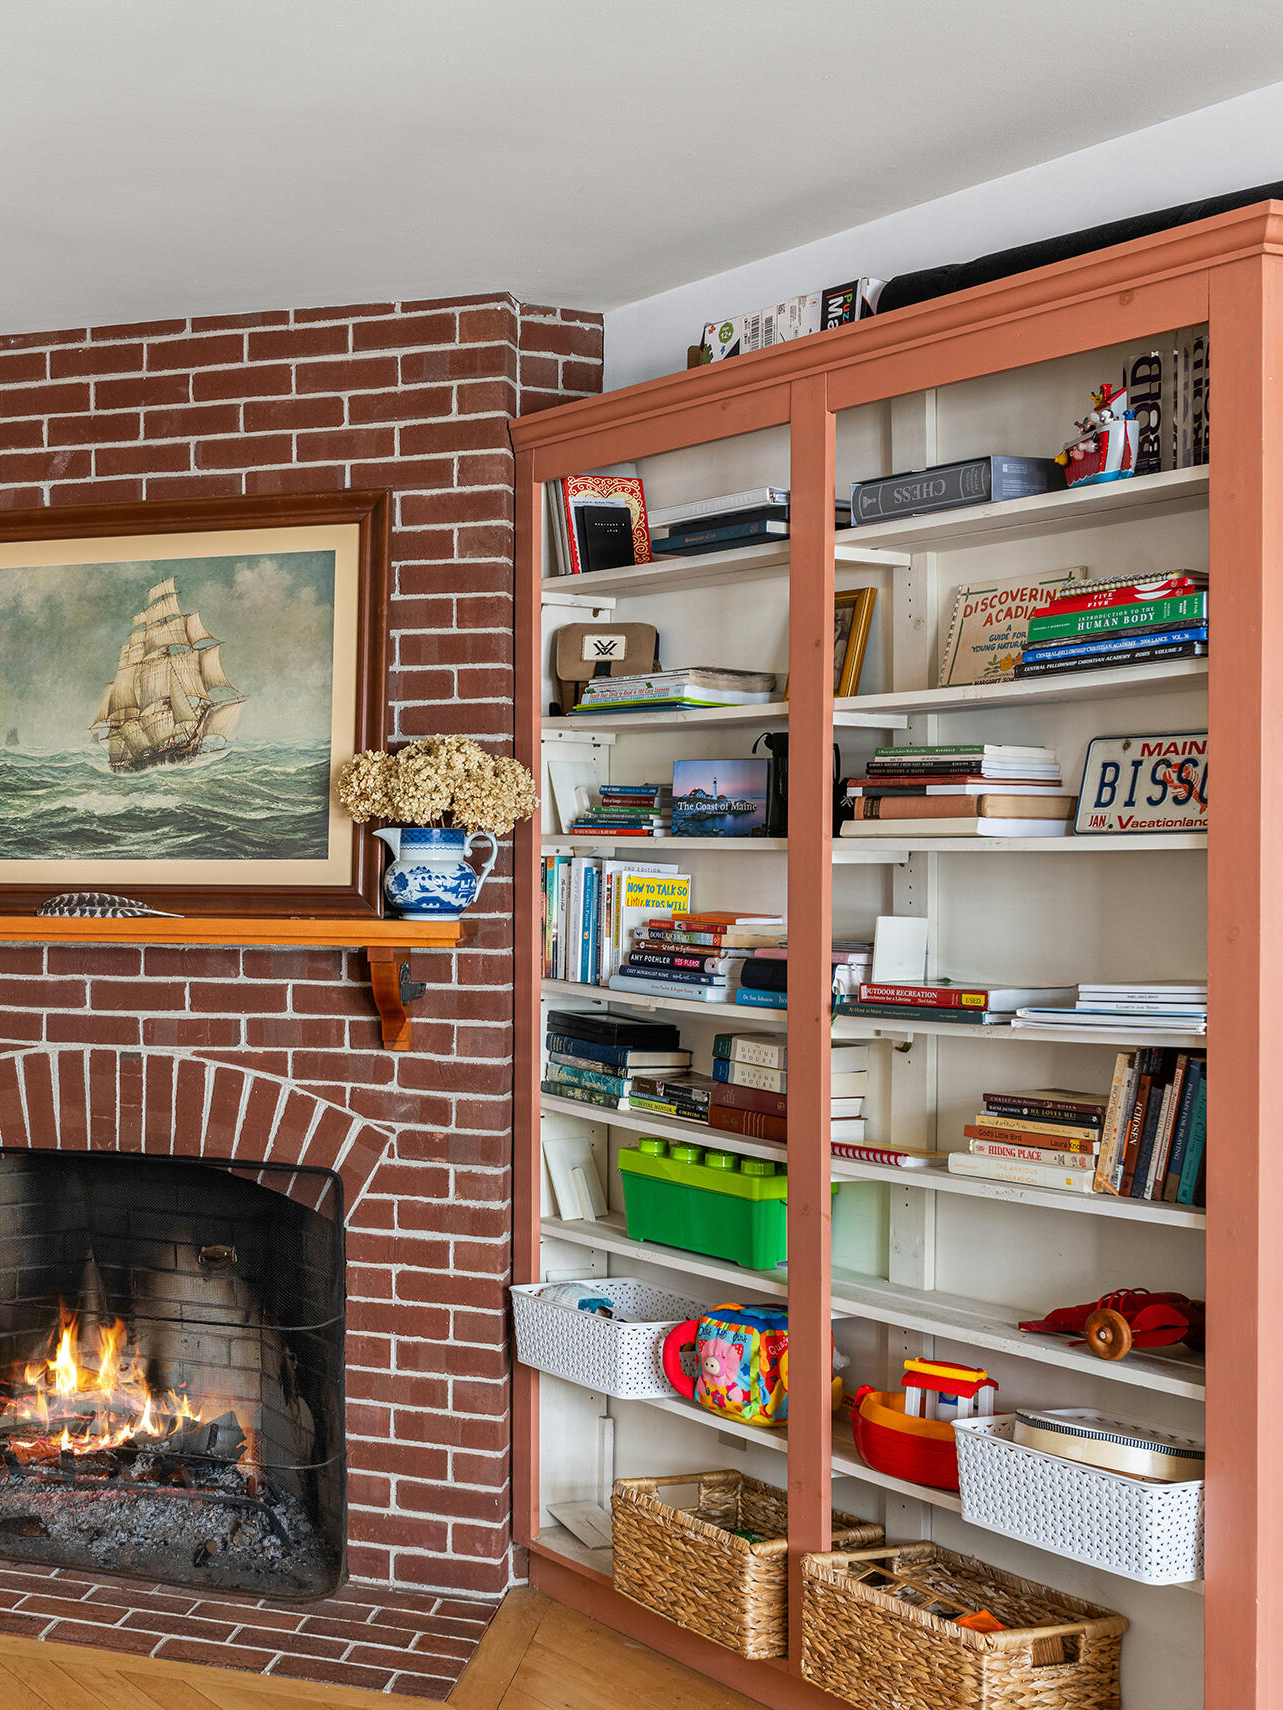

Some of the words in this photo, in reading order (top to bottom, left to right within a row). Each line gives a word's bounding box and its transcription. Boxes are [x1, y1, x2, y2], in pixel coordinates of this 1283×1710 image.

[893, 478, 947, 505] CHESS
[1093, 592, 1113, 600] FIVE
[962, 587, 1058, 619] DISCOVERIN
[1087, 600, 1109, 608] FIVE
[982, 605, 1038, 628] ACADIA
[1077, 618, 1119, 631] HUMAN
[1123, 612, 1156, 624] BODY
[1079, 612, 1128, 622] INTRODUCTION
[1006, 624, 1012, 632] A
[989, 632, 1014, 642] GUIDE
[1015, 631, 1027, 640] FOR
[971, 642, 996, 653] YOUNG
[1024, 664, 1045, 672] CENTRAL
[1047, 660, 1077, 669] FELLOWSHIP
[1078, 656, 1105, 665] CHRISTIAN
[1105, 653, 1131, 662] ACADEMY
[1140, 740, 1207, 758] MAIN
[678, 801, 693, 811] The
[696, 802, 718, 812] Coast
[719, 801, 730, 811] of
[731, 802, 757, 811] Maine
[1088, 815, 1107, 827] JAN
[627, 881, 644, 894] HOW
[645, 883, 655, 894] TO
[656, 884, 676, 895] TALK
[677, 886, 688, 896] SO
[667, 900, 687, 912] WILL
[630, 954, 643, 962] AMY
[643, 954, 671, 964] POEHLER
[675, 958, 683, 966] YES
[683, 960, 701, 968] PLEASE
[896, 990, 938, 998] RECREATION
[741, 1047, 775, 1059] DIVINE
[743, 1054, 774, 1065] HOURS
[741, 1070, 775, 1082] DIVINE
[743, 1077, 773, 1089] HOURS
[1180, 1112, 1189, 1126] FOR
[1129, 1106, 1143, 1146] CHOSEN
[979, 1128, 993, 1138] God's
[995, 1130, 1009, 1138] Little
[1010, 1133, 1021, 1141] Bird
[1051, 1140, 1068, 1148] Laura
[1174, 1128, 1185, 1160] PRAYING
[989, 1146, 1017, 1158] HIDING
[1017, 1147, 1042, 1161] PLACE
